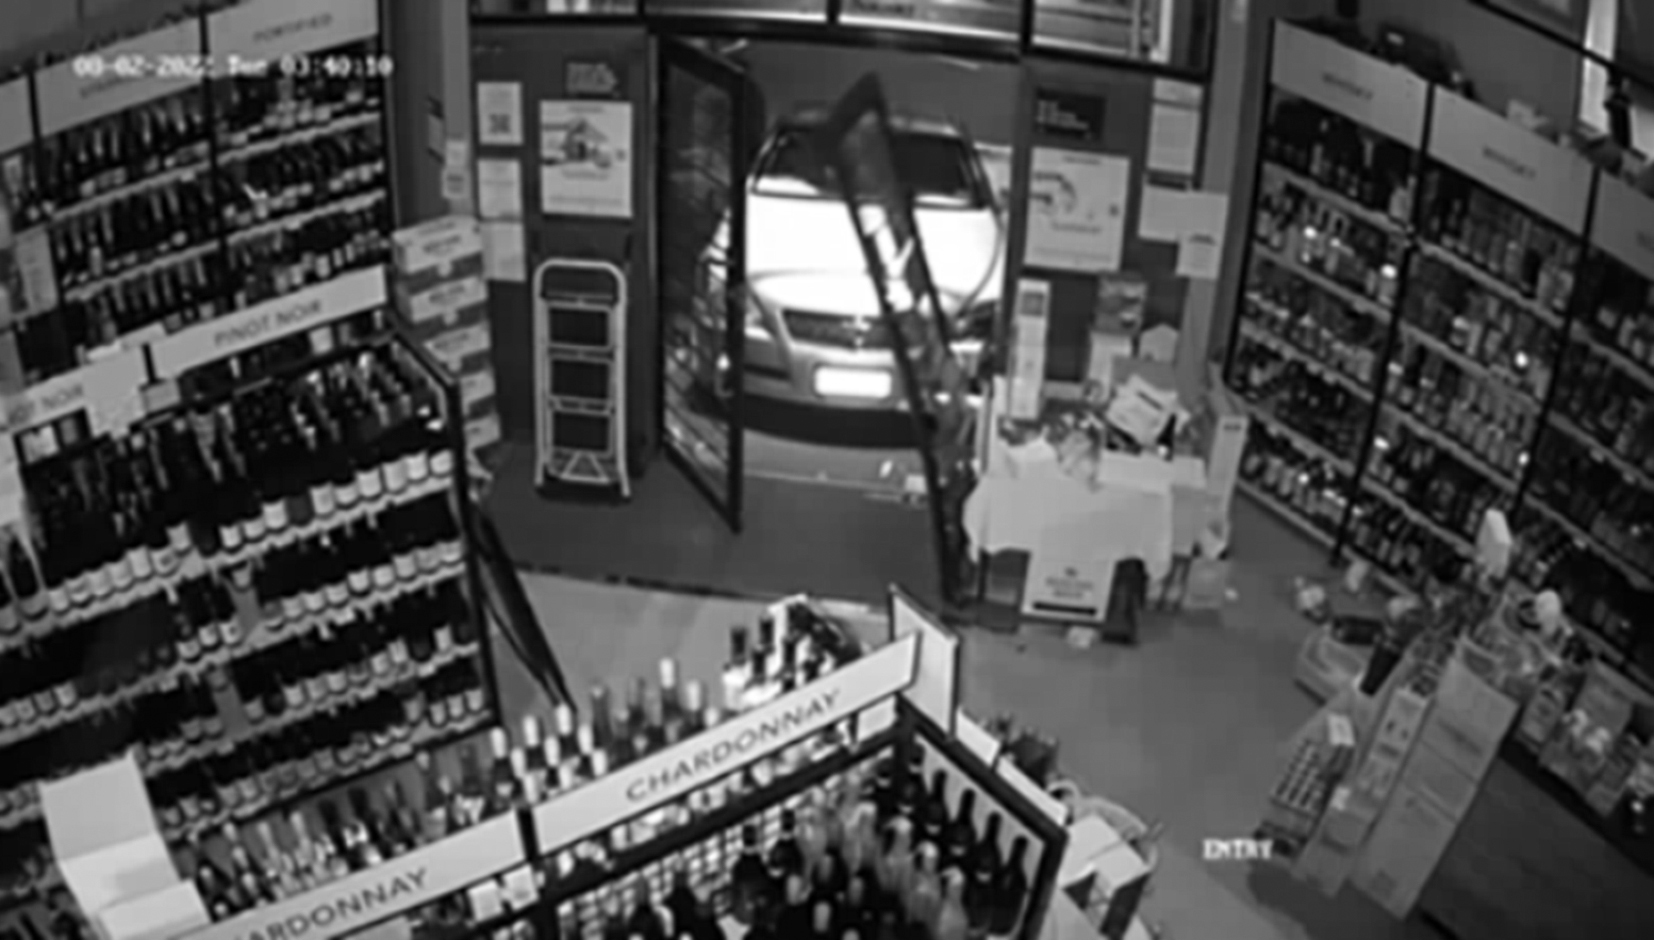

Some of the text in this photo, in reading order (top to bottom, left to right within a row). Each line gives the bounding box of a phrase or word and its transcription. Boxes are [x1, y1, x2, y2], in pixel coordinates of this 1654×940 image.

[213, 299, 322, 347] PINOT NOIR
[625, 686, 841, 802] CHARDONNAY
